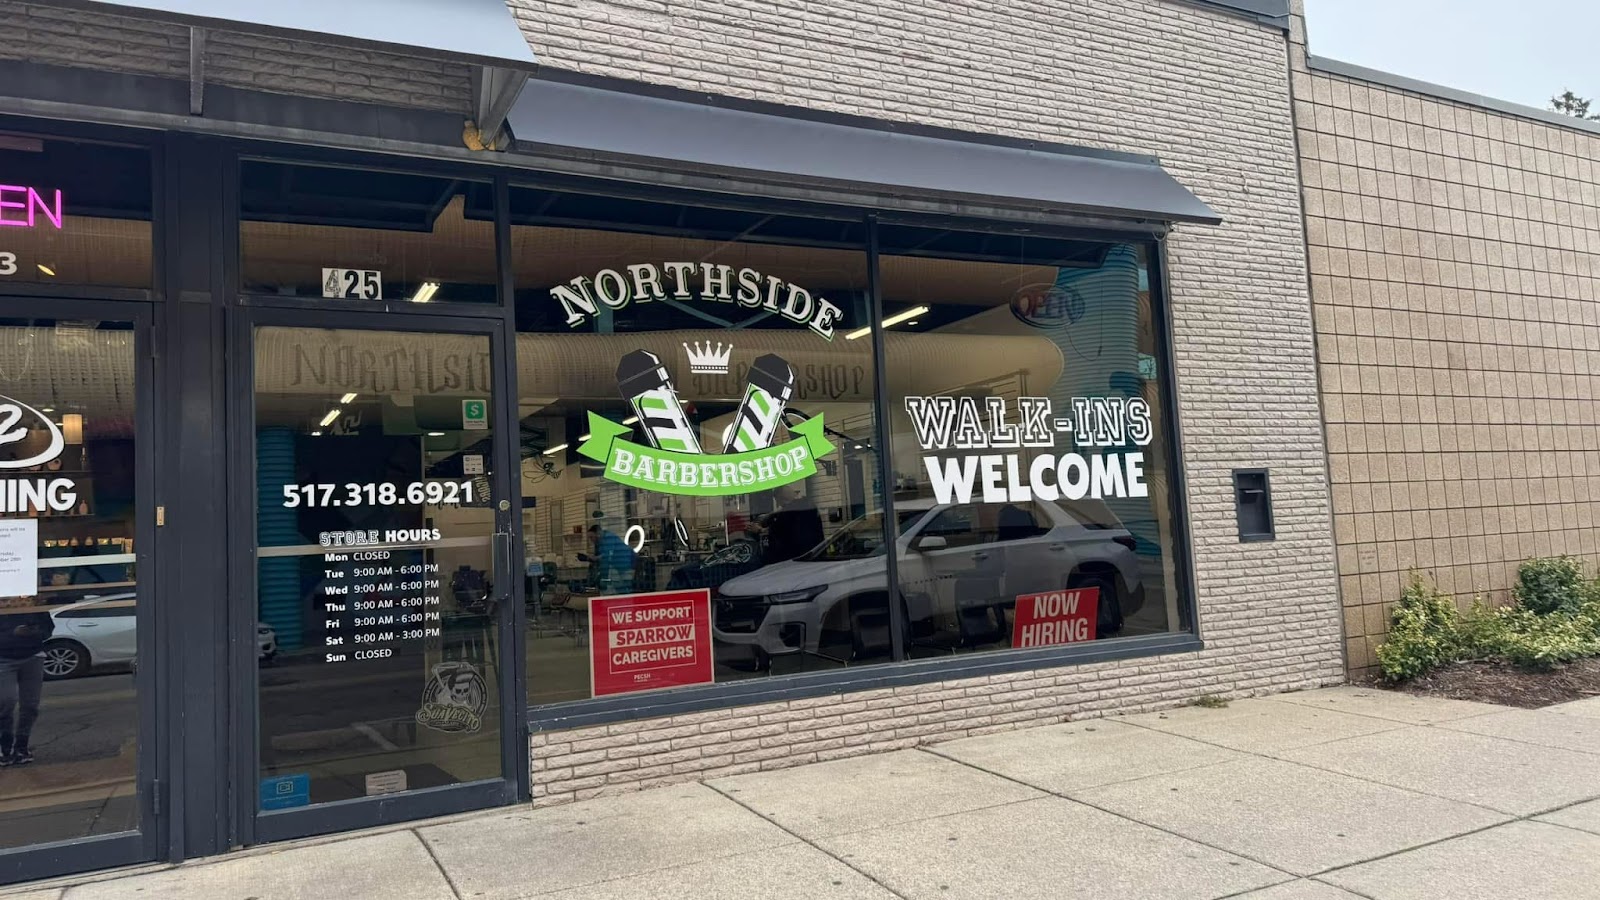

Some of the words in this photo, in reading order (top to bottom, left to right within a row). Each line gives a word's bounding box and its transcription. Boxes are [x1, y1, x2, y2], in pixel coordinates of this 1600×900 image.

[324, 269, 379, 300] 425
[550, 262, 843, 342] NORTHSIDE
[904, 396, 1153, 449] WALK-INS
[611, 445, 808, 488] BARBERSHOP
[923, 452, 1148, 504] WELCOME
[0, 478, 77, 511] ING
[283, 481, 473, 507] 517.318.6921
[319, 530, 379, 547] STORE
[385, 528, 441, 543] HOURS
[325, 553, 348, 562] Mon
[353, 551, 390, 561] CLOSED
[325, 570, 344, 579] Tue
[353, 568, 375, 577] 9:00
[377, 566, 393, 576] AM
[400, 565, 422, 575] 6:00
[424, 564, 439, 573] PM
[325, 586, 348, 595] Wed
[354, 584, 375, 594] 9:00
[377, 583, 393, 592] AM
[401, 581, 422, 591] 6:00
[425, 580, 439, 589] PM
[325, 603, 346, 612] Thu
[354, 601, 375, 611] 9:00
[378, 599, 393, 609] AM
[401, 597, 422, 607] 6:00
[425, 596, 439, 605] PM
[1033, 592, 1080, 619] NOW
[326, 620, 340, 628] Fri
[354, 617, 376, 627] 9:00
[378, 615, 393, 625] AM
[401, 613, 423, 623] 6:00
[425, 612, 439, 621] PM
[612, 611, 633, 624] WE
[635, 606, 691, 622] SUPPORT
[326, 637, 343, 646] Sat
[354, 634, 376, 644] 9:00
[378, 632, 394, 642] AM
[402, 630, 423, 639] 3:00
[425, 628, 440, 637] PM
[616, 625, 692, 646] SPARROW
[1020, 618, 1088, 648] HIRING
[326, 654, 346, 663] Sun
[354, 649, 392, 660] CLOSED
[612, 645, 693, 666] CAREGIVERS
